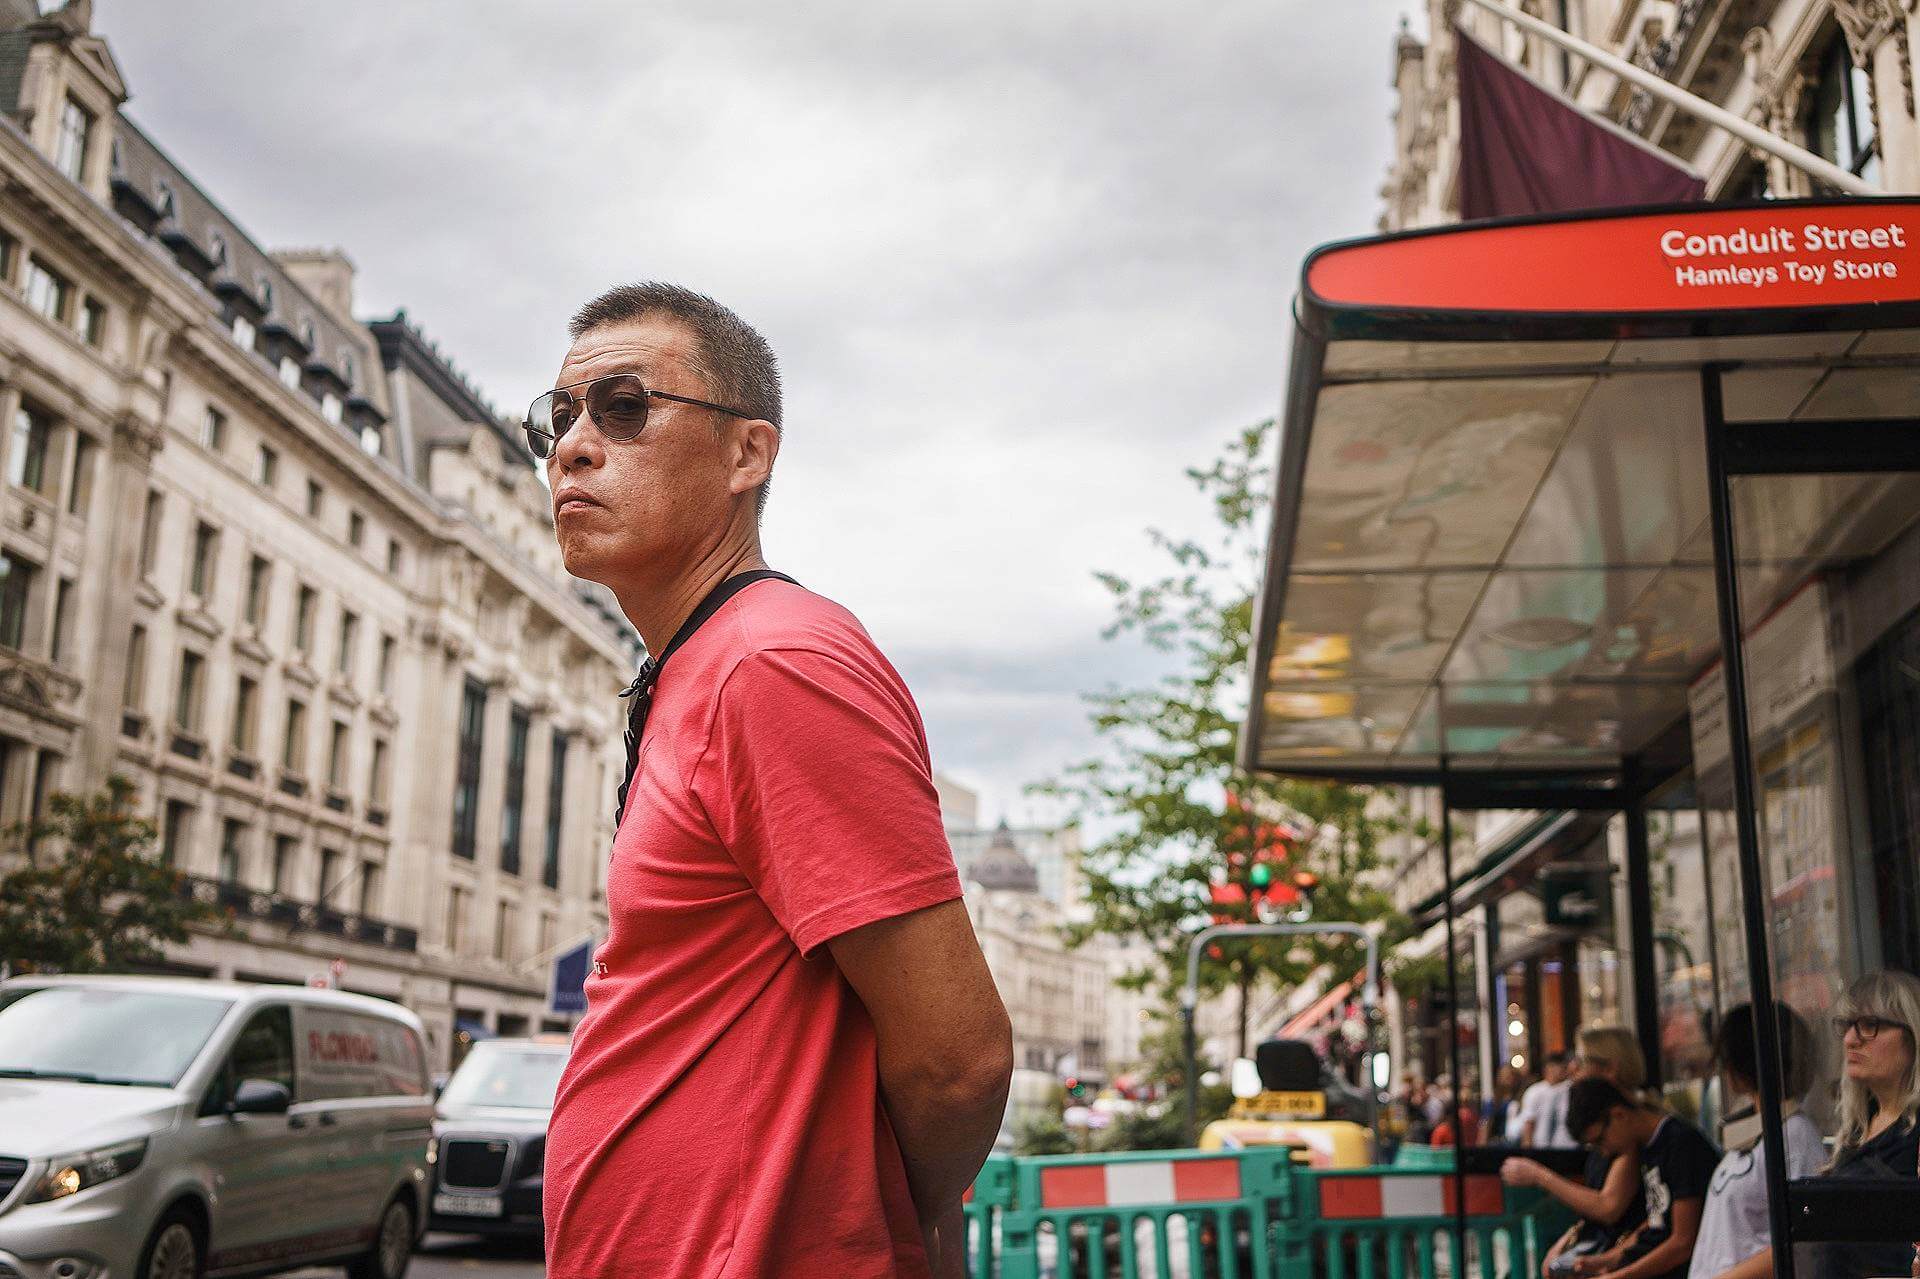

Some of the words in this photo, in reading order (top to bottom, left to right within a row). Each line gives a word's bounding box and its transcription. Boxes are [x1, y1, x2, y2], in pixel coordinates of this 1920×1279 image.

[1660, 226, 1796, 257] Conduit
[1803, 224, 1906, 252] Street
[1675, 263, 1779, 288] Hamleys
[1783, 261, 1826, 285] Toy
[1832, 259, 1898, 280] Store
